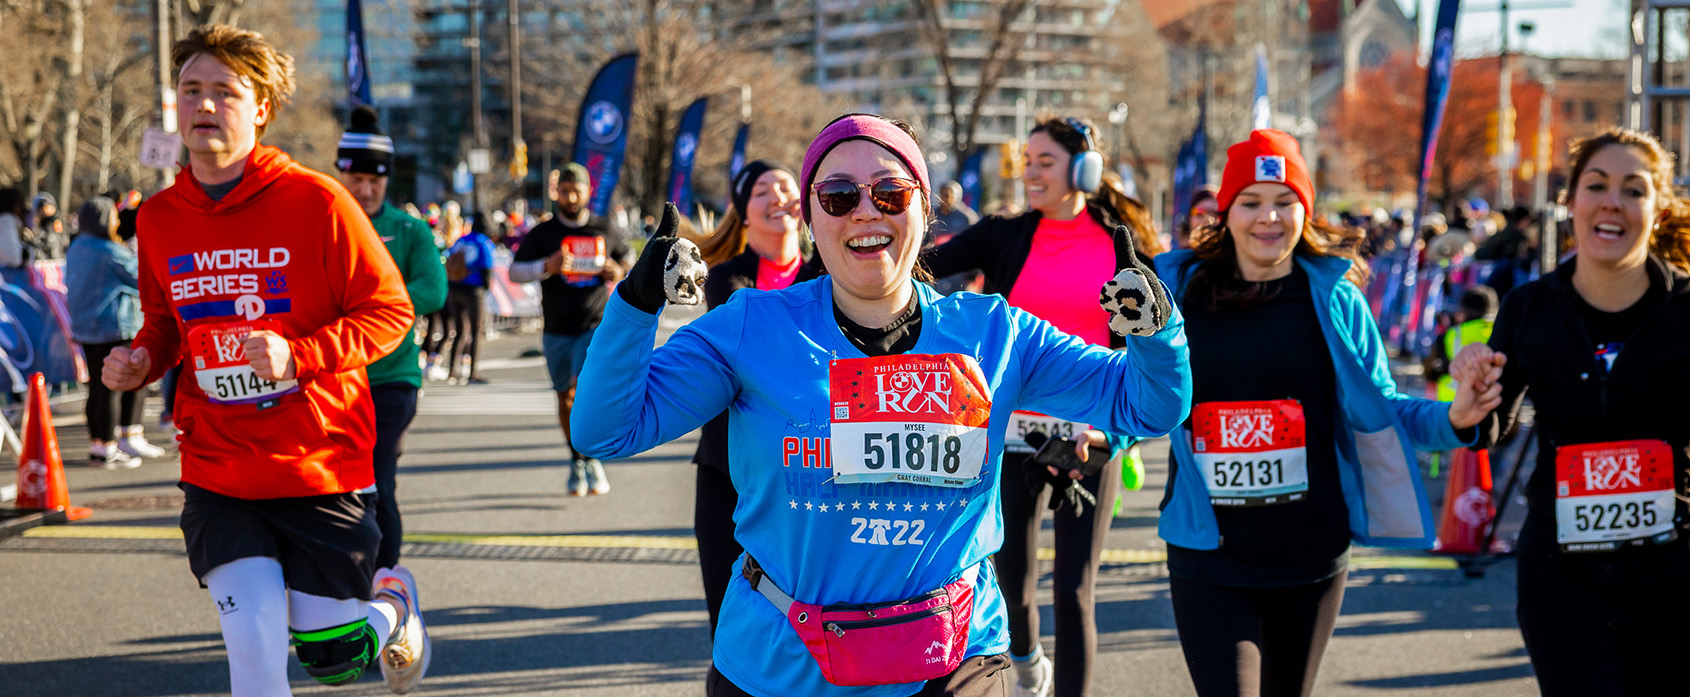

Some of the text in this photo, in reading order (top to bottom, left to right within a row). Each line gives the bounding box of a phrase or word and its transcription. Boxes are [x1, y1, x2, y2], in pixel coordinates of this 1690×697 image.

[194, 247, 291, 271] WORLD
[171, 274, 259, 301] SERIES
[216, 346, 247, 363] RU
[874, 363, 950, 373] PHILADELPHIA
[874, 372, 952, 394] LOVE
[875, 388, 952, 415] RUN
[1219, 414, 1274, 433] LOVE
[1220, 428, 1275, 448] RUN
[864, 433, 962, 474] 51818
[1214, 459, 1284, 487] 52131
[1583, 455, 1642, 475] LOVE
[912, 475, 932, 483] CORRAL
[1585, 469, 1643, 491] RUN
[1575, 501, 1657, 531] 52235
